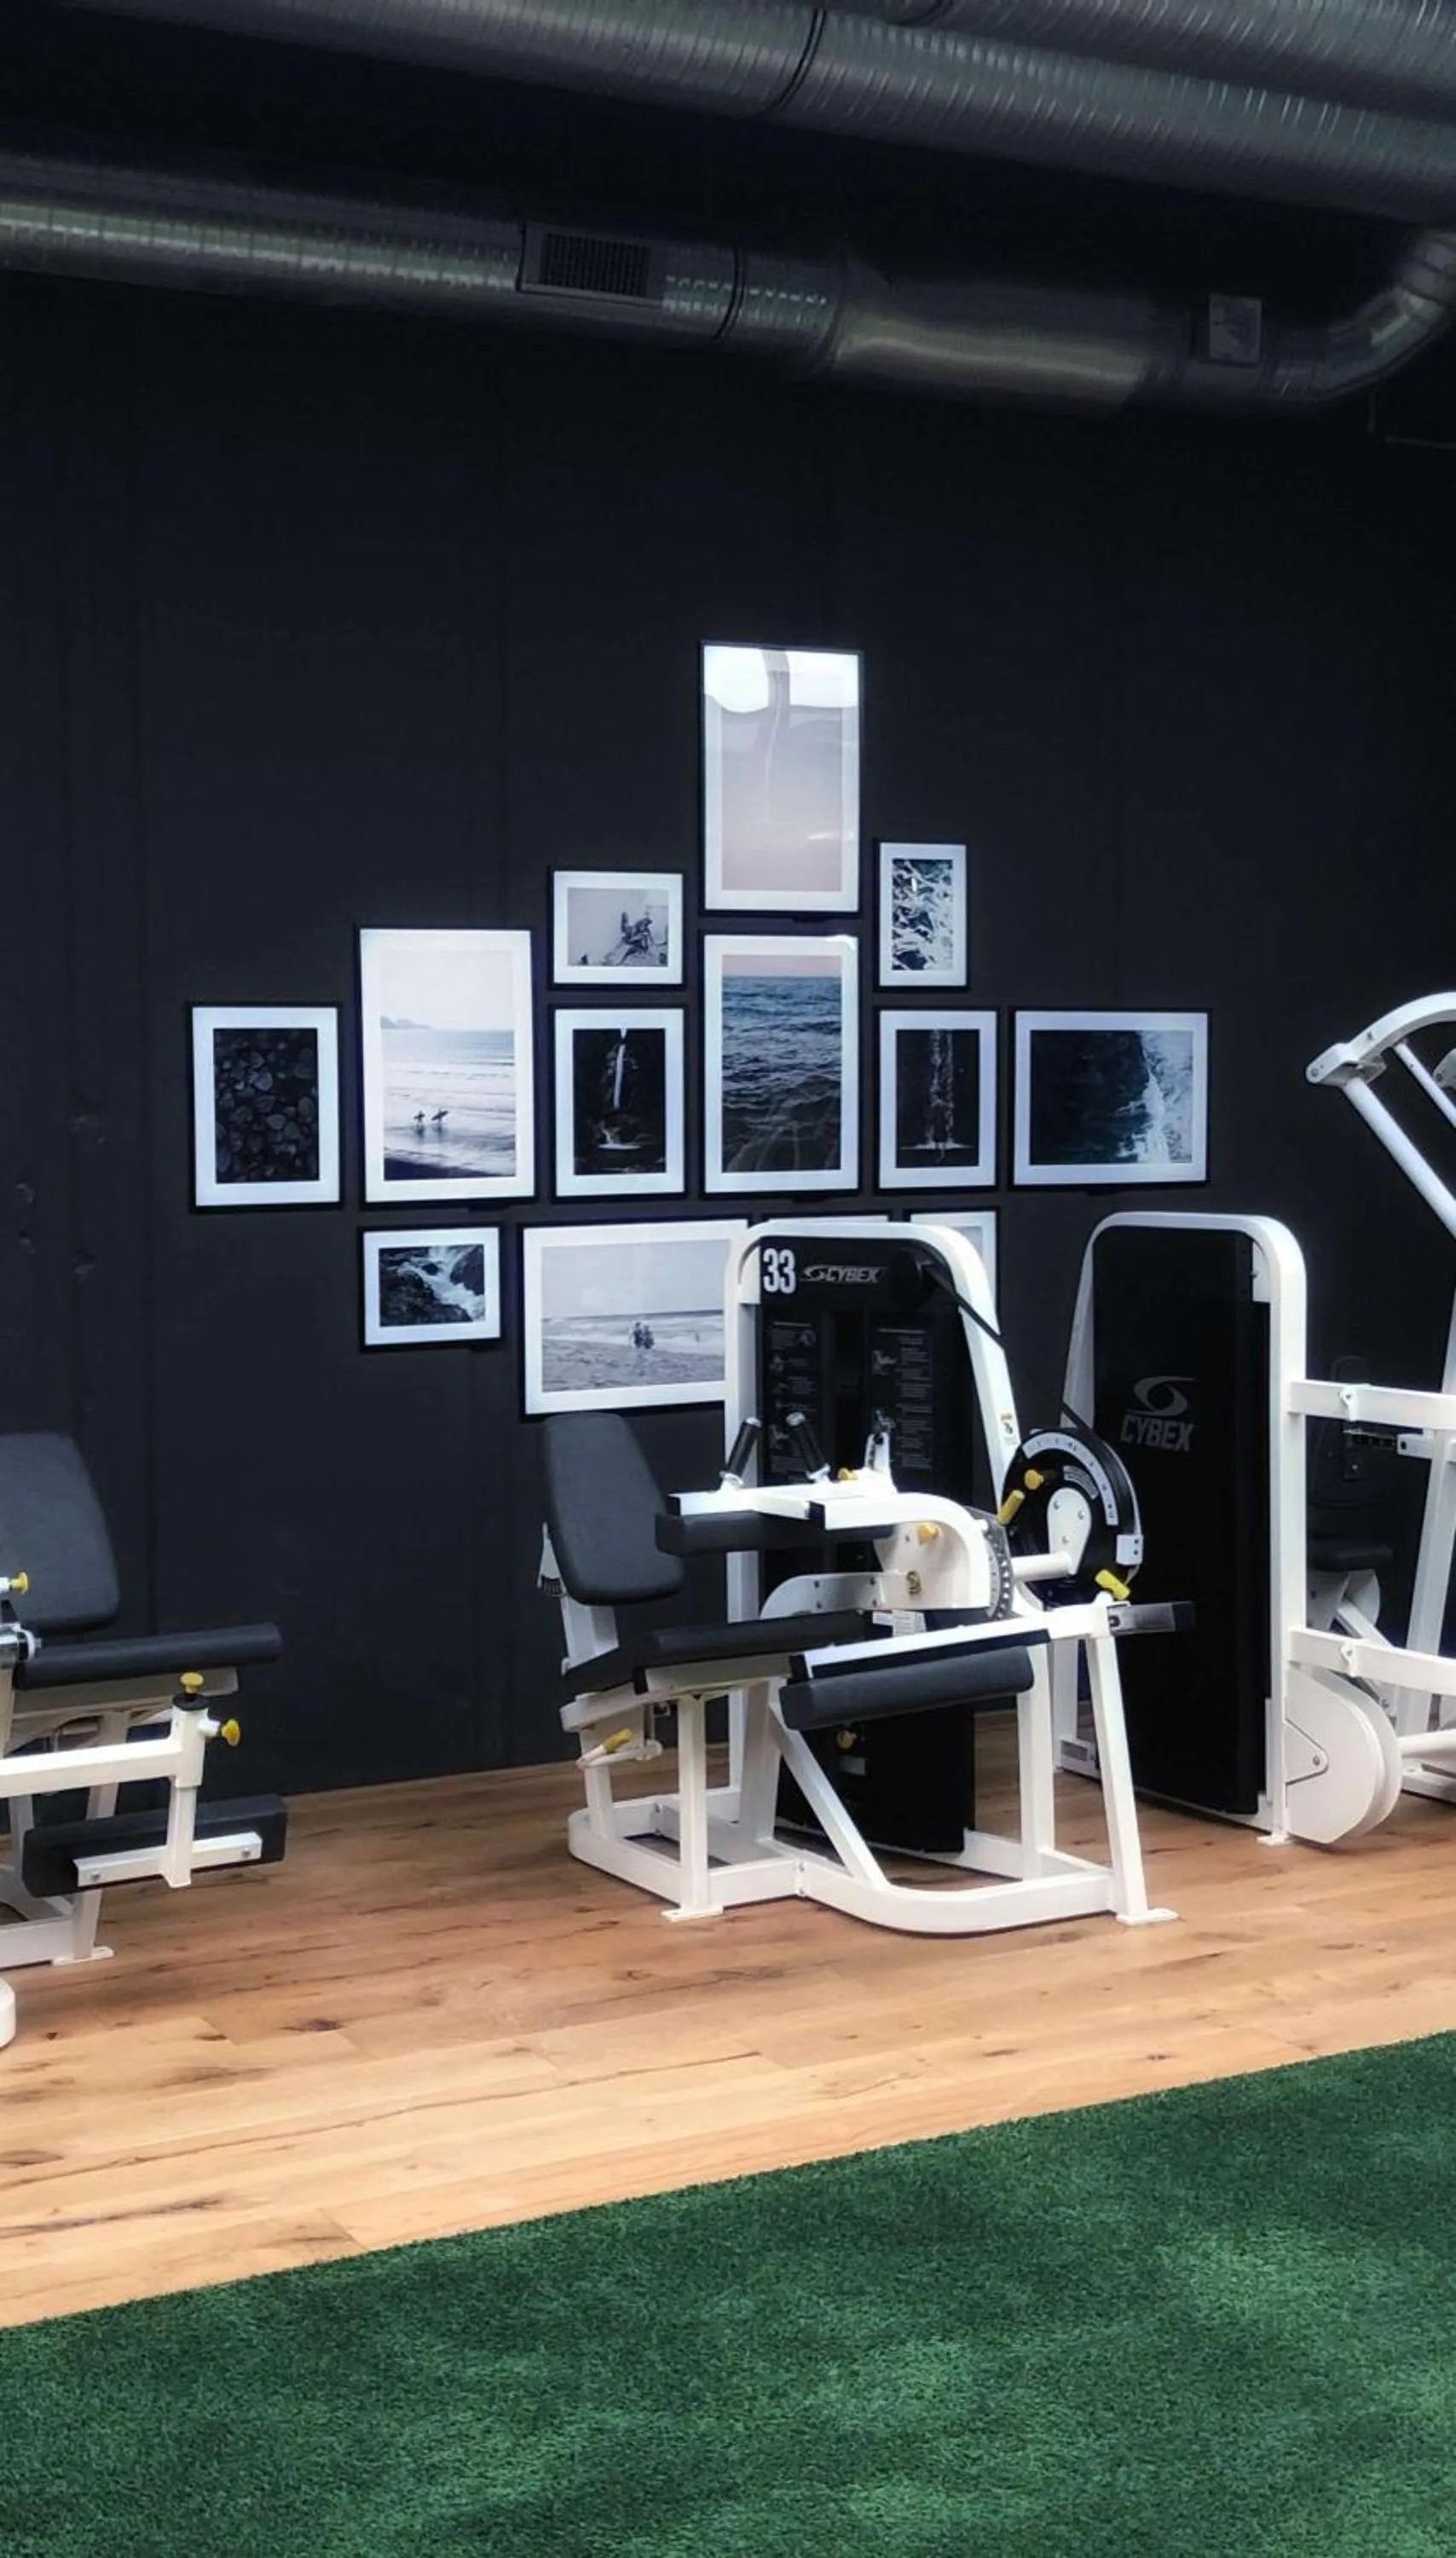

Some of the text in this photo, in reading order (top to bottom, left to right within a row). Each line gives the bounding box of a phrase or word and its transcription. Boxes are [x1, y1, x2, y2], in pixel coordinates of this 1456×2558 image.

[763, 1247, 796, 1293] 33
[826, 1267, 881, 1283] CYBEX
[1120, 1415, 1194, 1452] CYBEX
